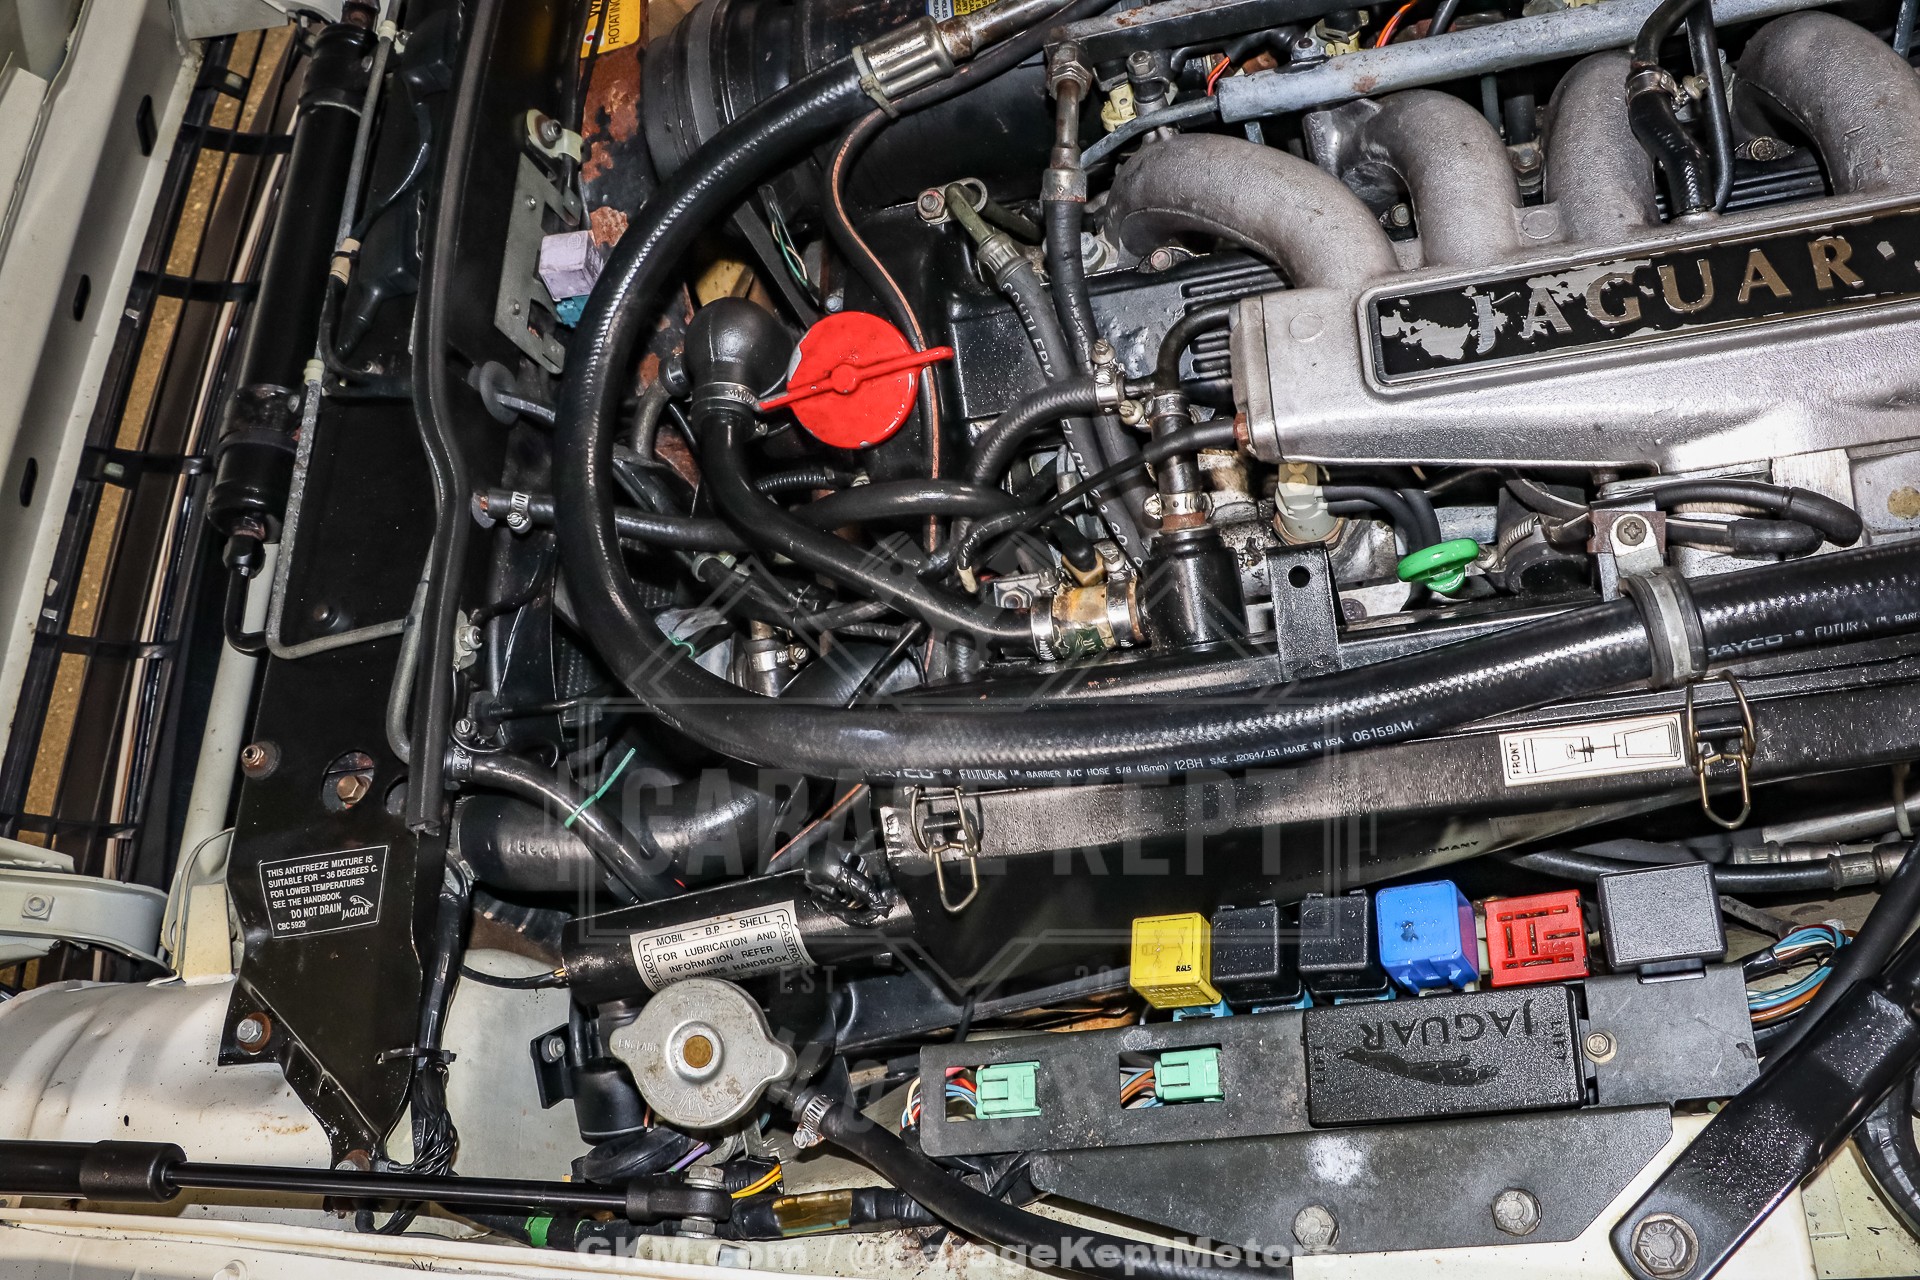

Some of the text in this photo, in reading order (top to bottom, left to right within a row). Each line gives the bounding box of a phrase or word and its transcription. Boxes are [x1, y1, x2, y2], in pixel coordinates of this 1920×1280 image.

[1474, 236, 1864, 355] JAGUAR
[1814, 620, 1869, 639] FUTURA
[959, 768, 1007, 782] FUTURA
[1025, 769, 1061, 779] BARRIER
[1066, 768, 1082, 778] A/C
[1086, 766, 1109, 776] HOSE
[1115, 765, 1132, 775] 5/8
[1209, 755, 1228, 766] SAE
[1283, 743, 1309, 754] MADE
[1312, 740, 1322, 749] IN
[1325, 736, 1345, 747] USA
[1352, 720, 1415, 743] 06159AM
[1509, 741, 1521, 775] FRONT
[266, 855, 373, 878] THIS ANTIFREEZE MIXTURE IS
[268, 875, 302, 888] SUITABLE
[303, 873, 318, 883] FOR
[326, 870, 335, 879] 36
[336, 865, 369, 878] DEGREES
[270, 877, 365, 899] FOR LOWER TEMPERATURES
[272, 900, 287, 909] SEE
[288, 897, 302, 907] THE
[290, 902, 342, 919] DO NOT DRAIN
[341, 906, 370, 921] JAGUAR
[277, 919, 306, 931] CBC 5929
[655, 934, 686, 947] MOBIL
[739, 915, 771, 929] SHELL
[657, 930, 777, 963] FOR LUBRICATION AND
[780, 922, 803, 964] CASTROL
[642, 954, 663, 988] TEXACO
[668, 945, 774, 974] INFORMATION REFER
[733, 954, 789, 971] HANDBOOK
[1358, 998, 1535, 1051] JAGUAR
[1550, 1019, 1566, 1061] LIFT
